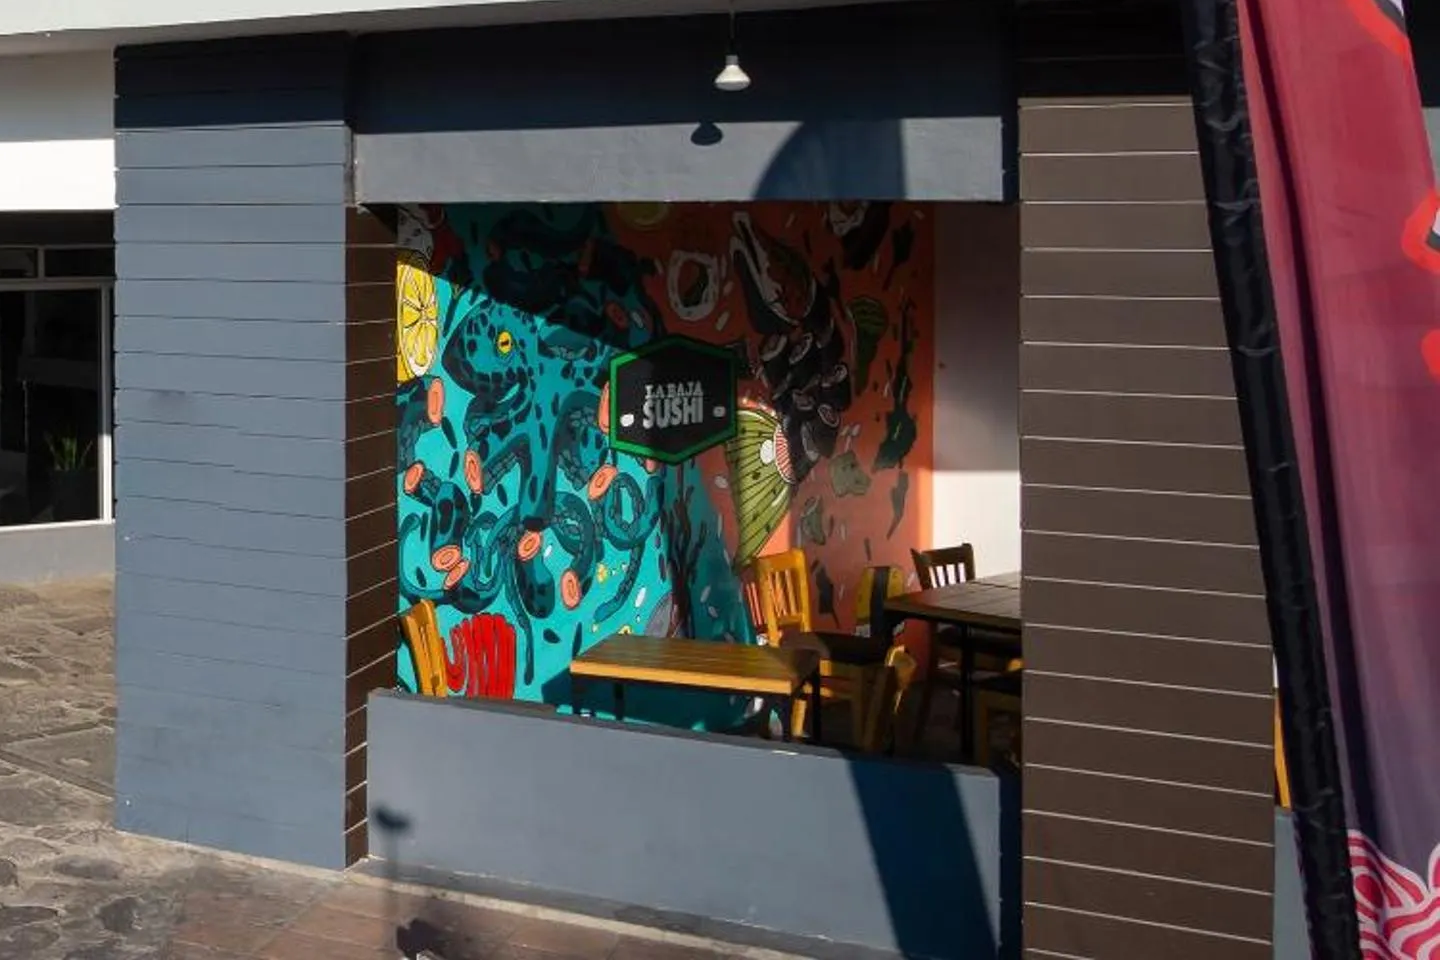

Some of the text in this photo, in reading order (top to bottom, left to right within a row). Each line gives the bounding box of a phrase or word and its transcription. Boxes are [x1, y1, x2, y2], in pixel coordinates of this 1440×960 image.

[644, 381, 704, 399] LA BAJA
[642, 397, 704, 429] SUSHI
